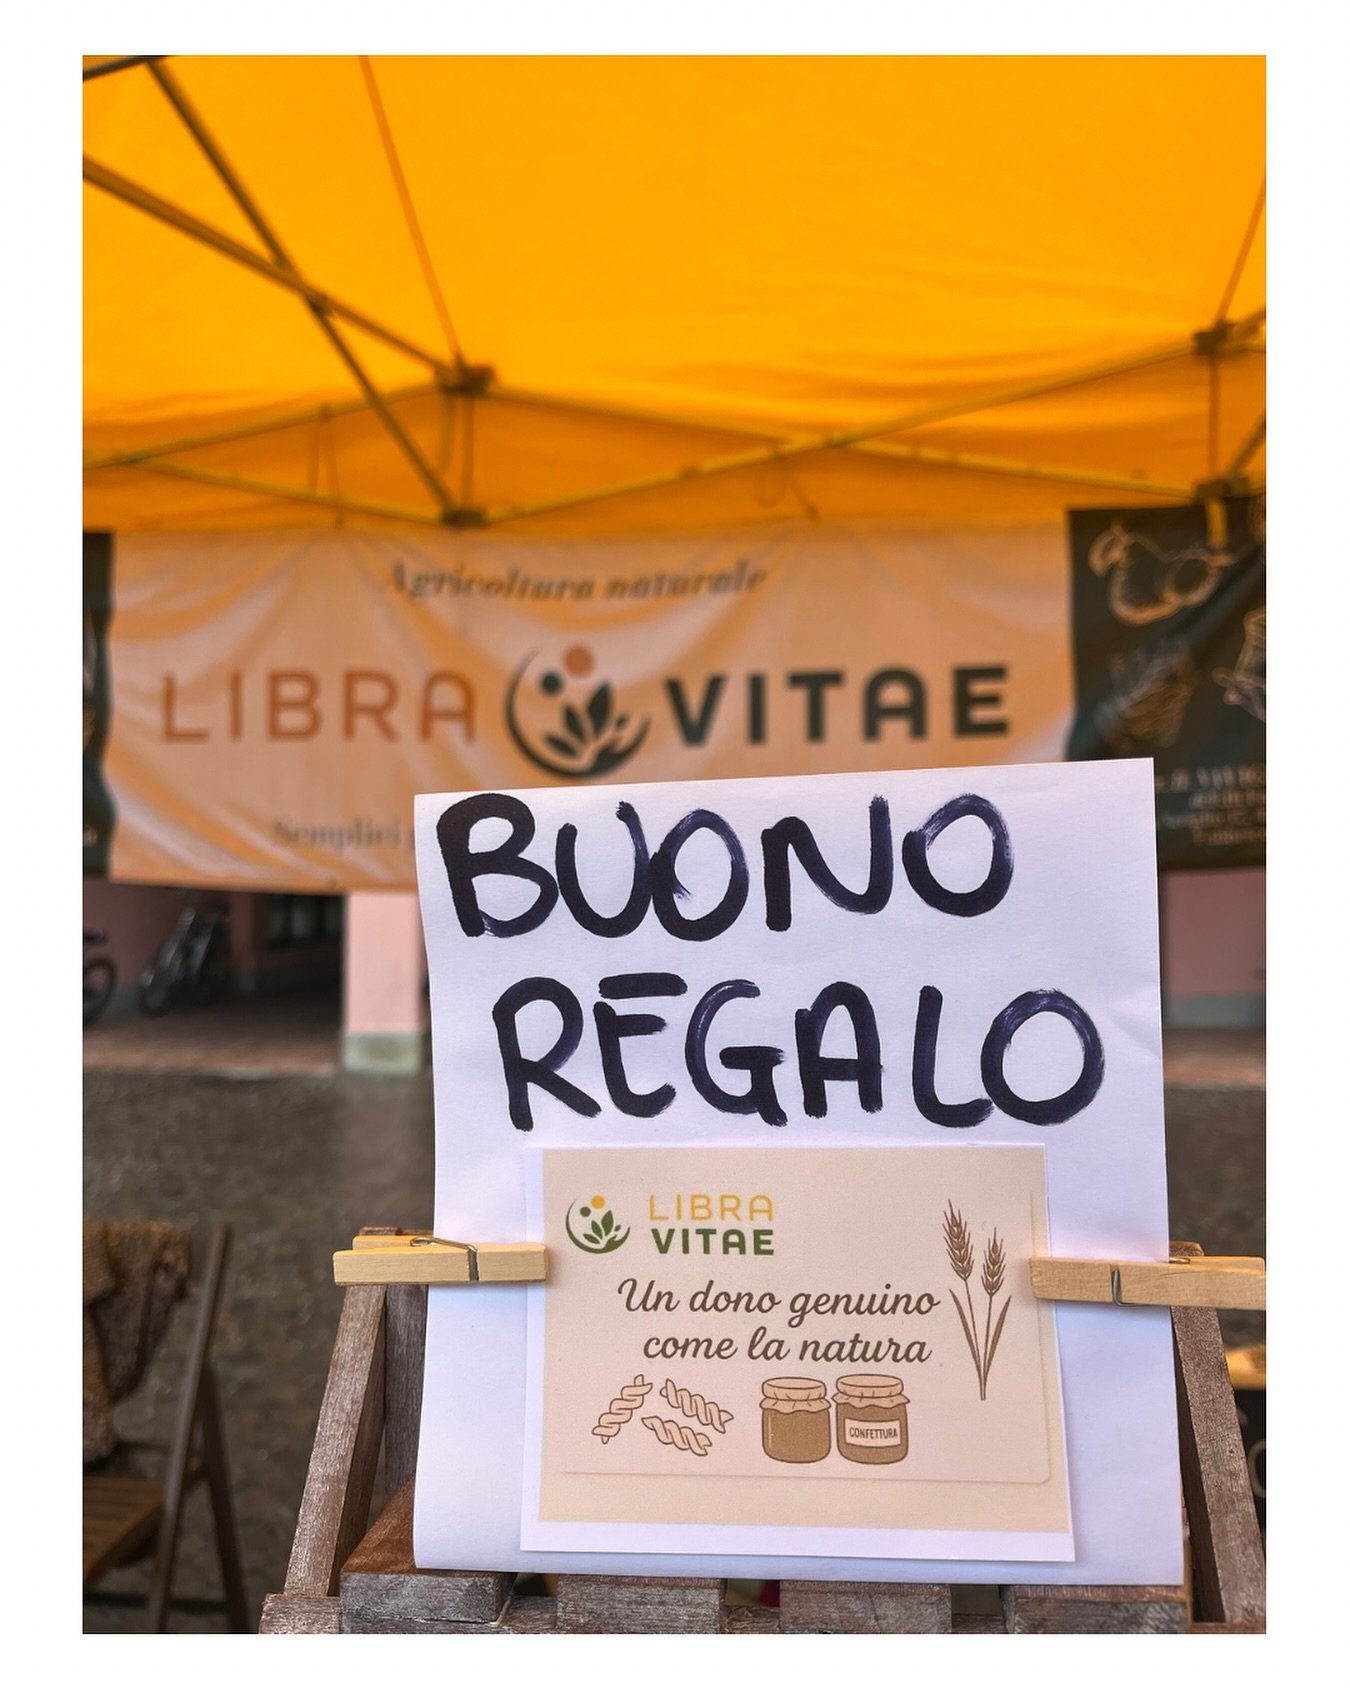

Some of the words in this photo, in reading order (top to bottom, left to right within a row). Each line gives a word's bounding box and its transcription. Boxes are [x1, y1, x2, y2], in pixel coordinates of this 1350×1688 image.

[606, 557, 769, 600] naturale
[161, 666, 478, 744] LIBRA
[664, 663, 1010, 748] VITAE
[437, 793, 1013, 942] BUONO
[492, 972, 1105, 1131] REGALO
[649, 1194, 774, 1222] LIBRA
[650, 1227, 775, 1256] VITAE
[617, 1278, 681, 1312] Un
[689, 1279, 782, 1313] dono
[787, 1283, 941, 1328] genuino
[643, 1336, 739, 1360] come
[747, 1326, 790, 1361] la
[799, 1333, 933, 1363] natura
[849, 1426, 899, 1439] CONFETTURA
